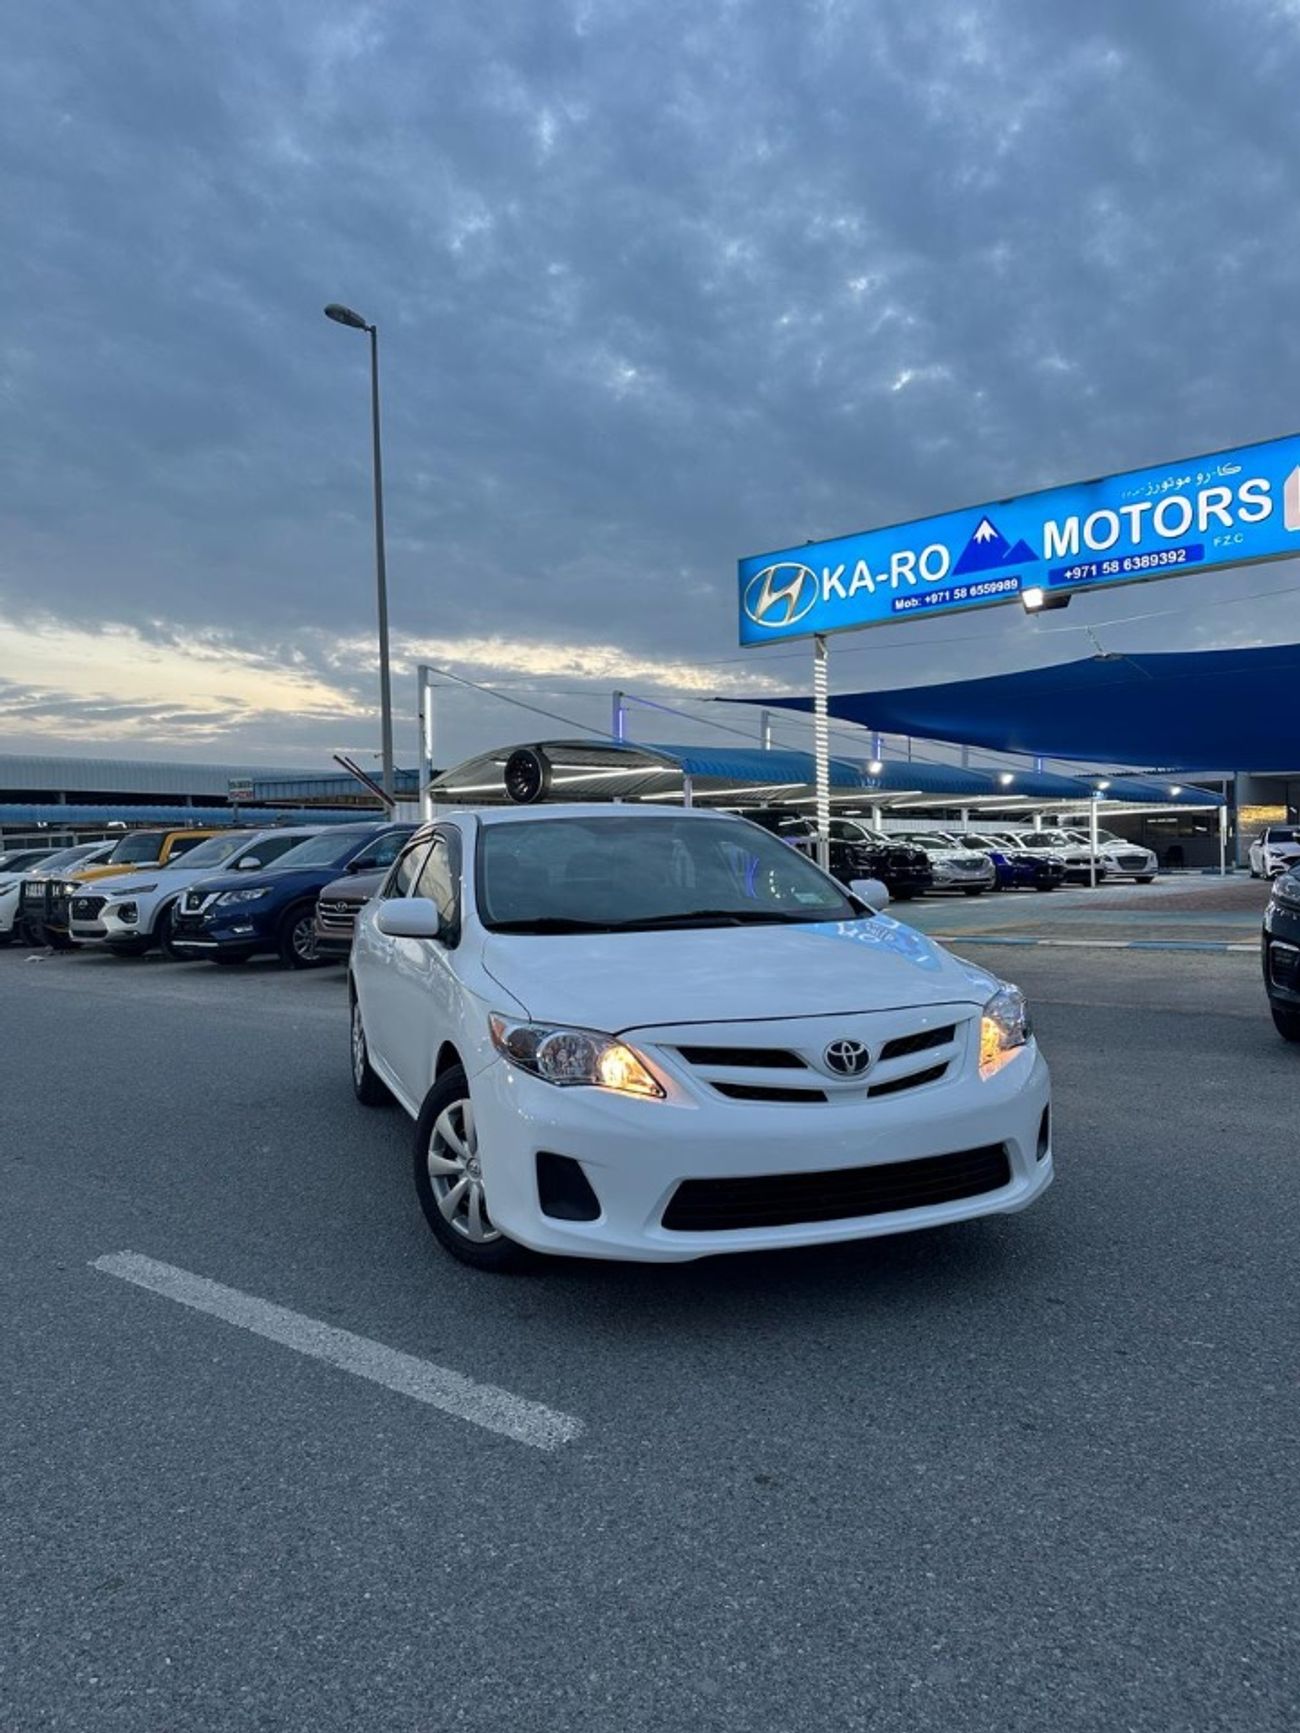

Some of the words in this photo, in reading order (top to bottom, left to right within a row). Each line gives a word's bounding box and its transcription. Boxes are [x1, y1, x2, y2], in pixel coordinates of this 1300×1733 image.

[1043, 478, 1273, 560] MOTORS
[822, 543, 950, 601] KA-RO
[1064, 564, 1097, 580] +971
[1102, 560, 1119, 574] 58
[1123, 549, 1186, 571] 6389392
[895, 597, 922, 610] Mob:
[925, 591, 949, 605] +971
[953, 587, 967, 600] 58
